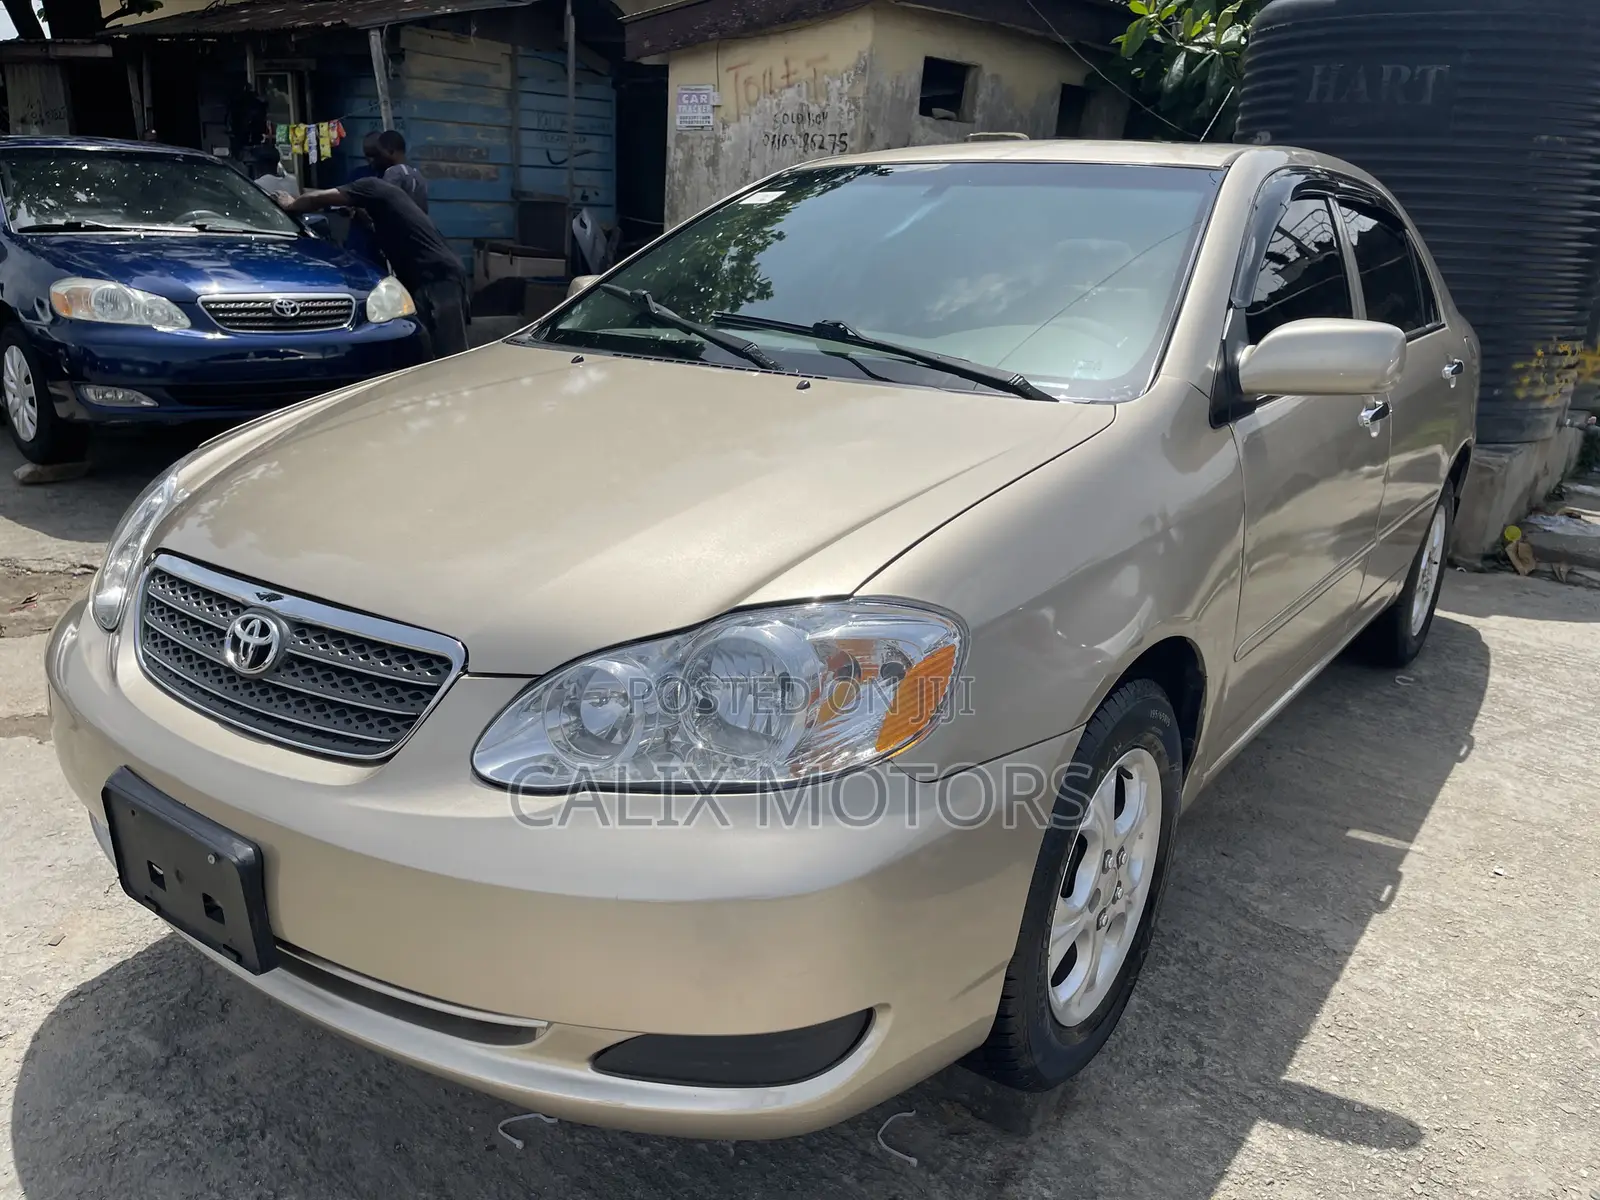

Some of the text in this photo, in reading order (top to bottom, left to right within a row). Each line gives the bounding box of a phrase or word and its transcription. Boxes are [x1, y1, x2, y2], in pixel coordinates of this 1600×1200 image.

[1305, 63, 1451, 105] HART
[681, 94, 708, 104] CAR
[678, 105, 712, 113] TRACKER
